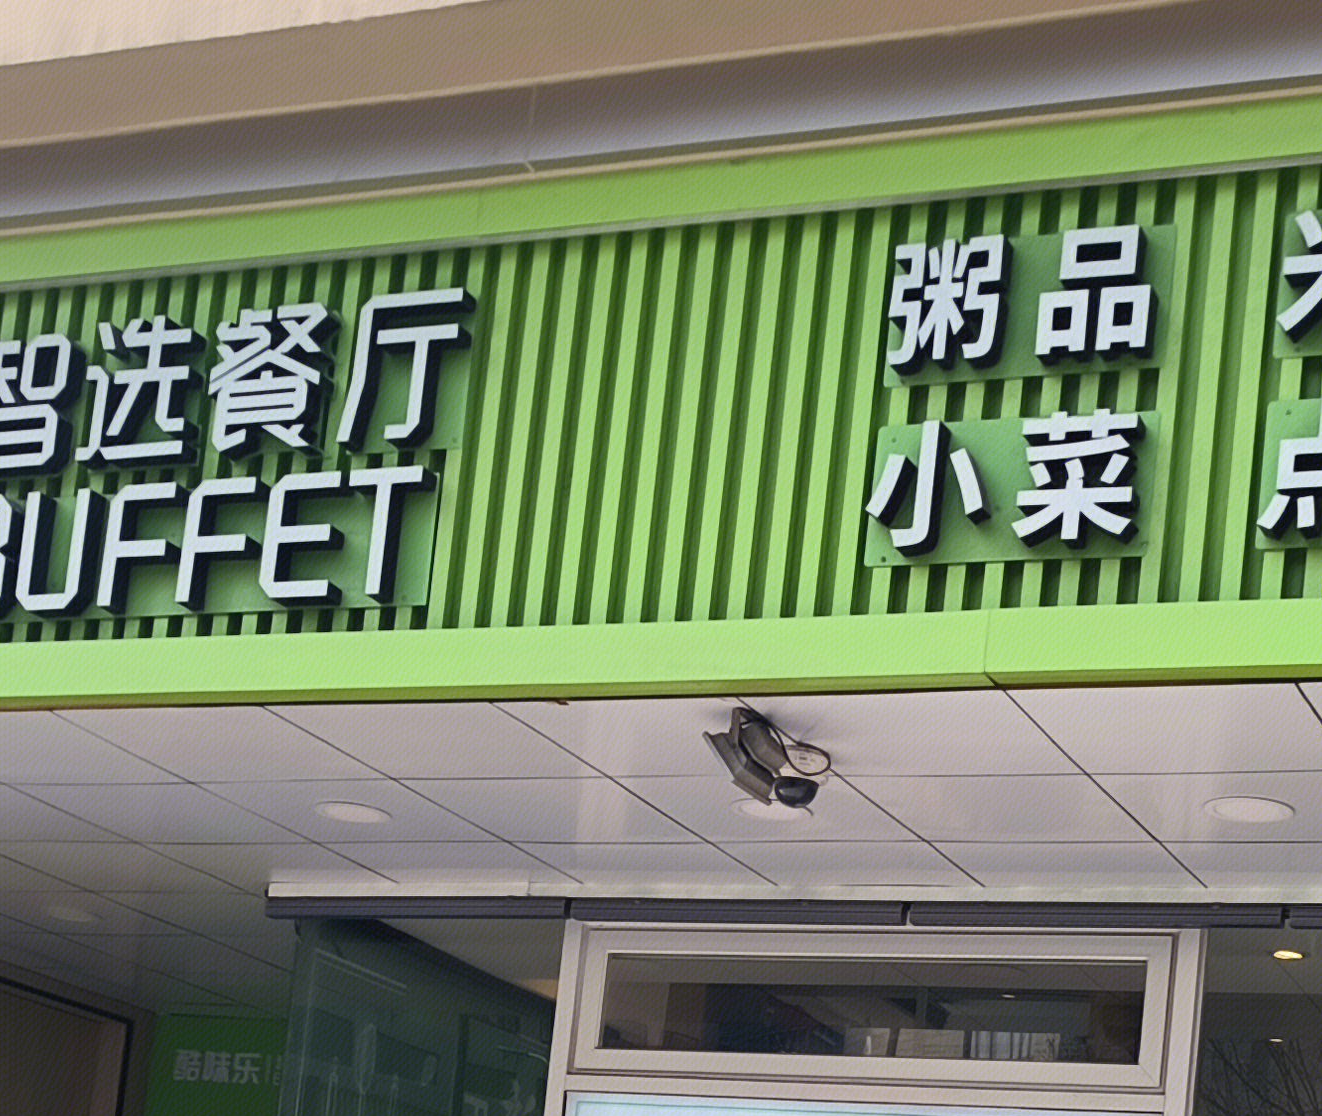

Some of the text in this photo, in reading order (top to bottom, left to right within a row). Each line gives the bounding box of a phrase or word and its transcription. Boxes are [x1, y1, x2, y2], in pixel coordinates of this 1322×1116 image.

[885, 224, 1153, 372] 粥品
[865, 408, 1143, 556] 小菜
[173, 1050, 262, 1085] 酷味乐
